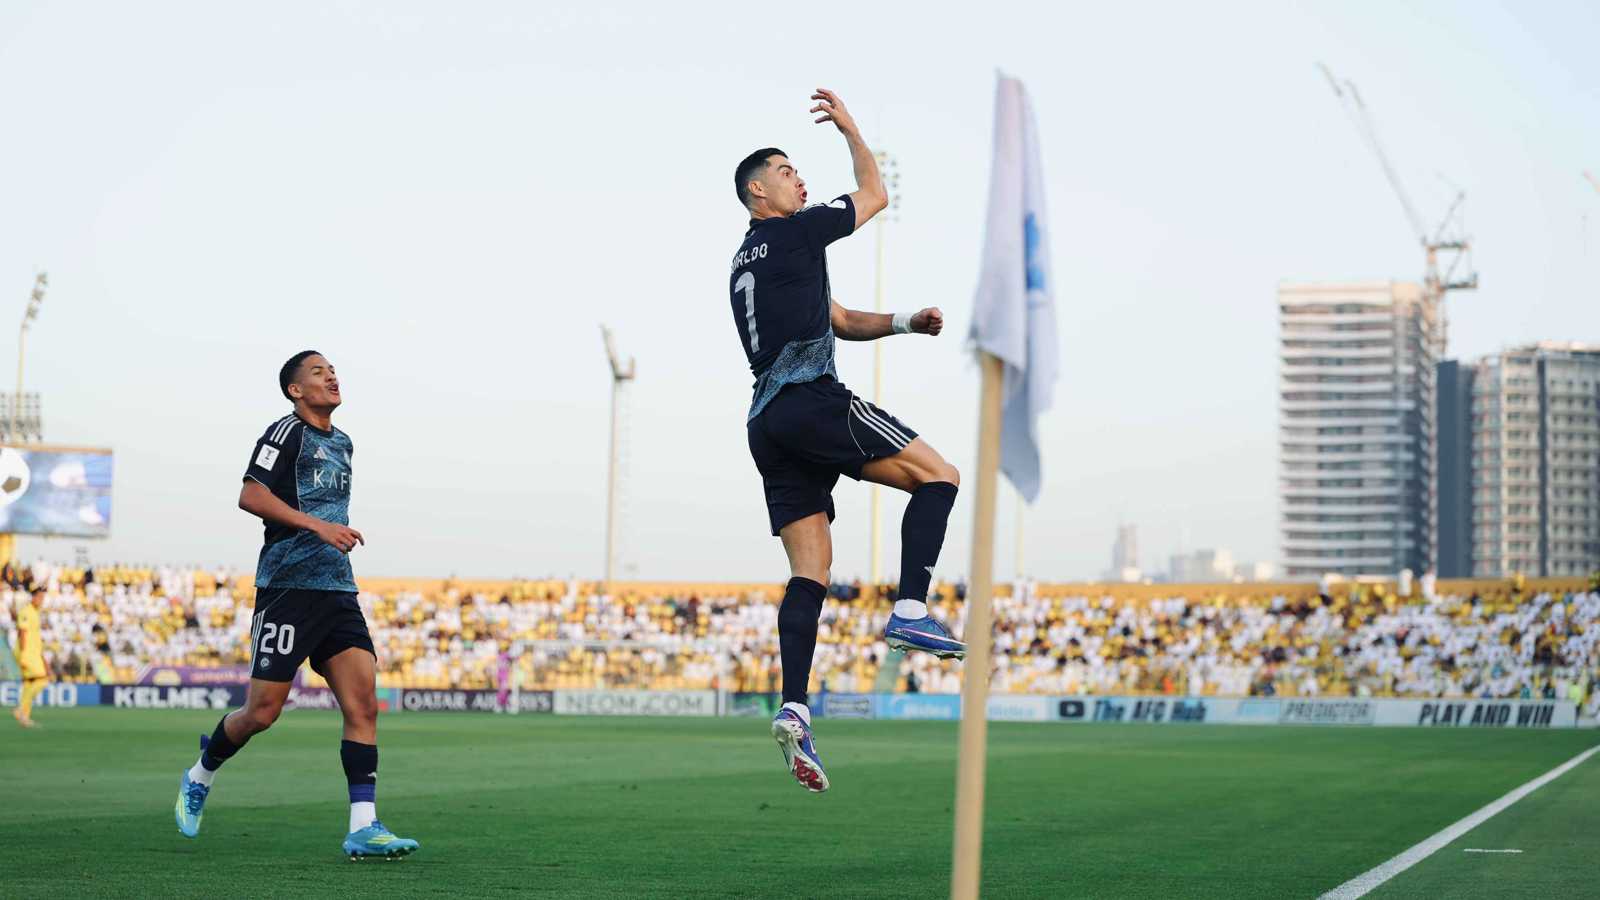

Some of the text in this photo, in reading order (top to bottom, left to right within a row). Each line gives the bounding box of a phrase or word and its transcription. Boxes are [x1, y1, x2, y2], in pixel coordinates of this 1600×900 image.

[734, 271, 760, 353] 7
[313, 469, 353, 490] KAF
[260, 622, 295, 655] 20
[113, 686, 208, 709] KELME
[403, 690, 467, 711] QATAR
[1093, 699, 1124, 721] The
[1418, 703, 1555, 726] PLAY AND WIN
